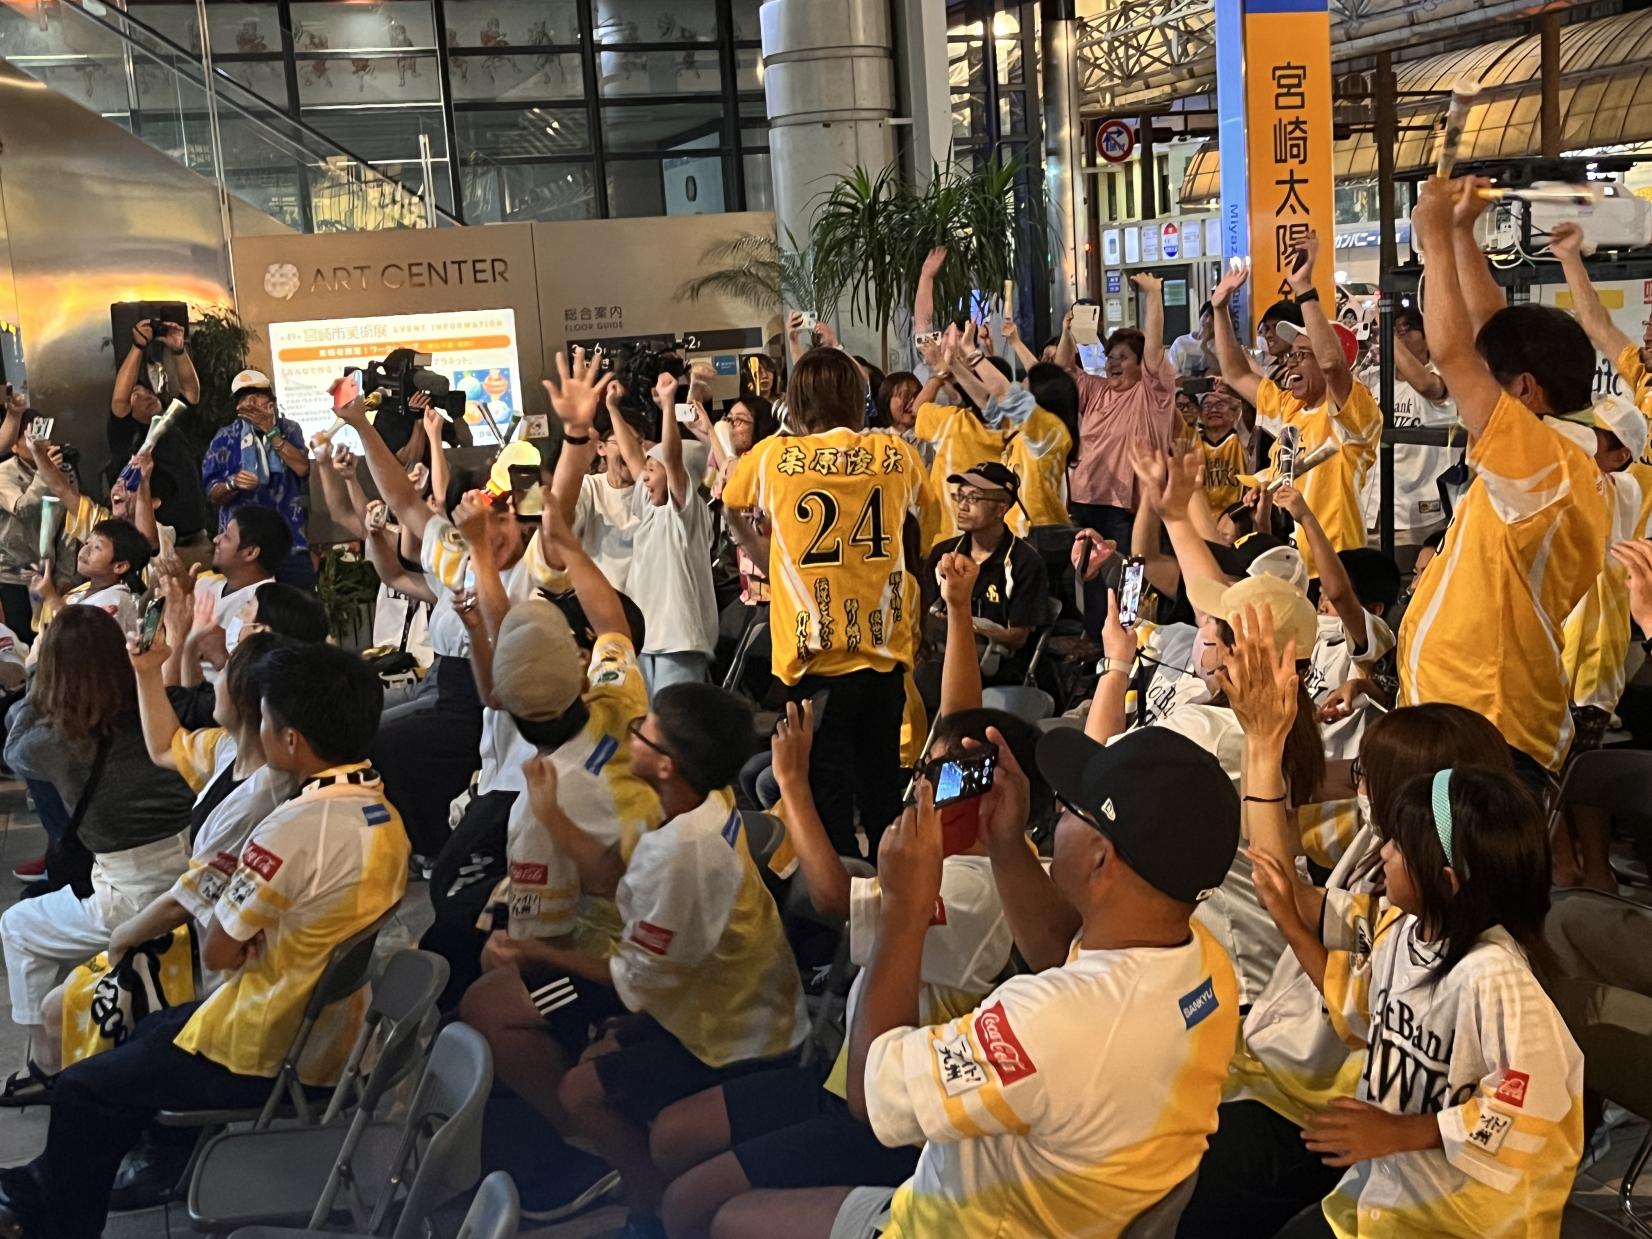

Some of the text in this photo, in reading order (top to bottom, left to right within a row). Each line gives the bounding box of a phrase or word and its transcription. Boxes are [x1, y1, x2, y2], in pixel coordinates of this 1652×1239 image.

[311, 258, 509, 292] ART CENTER
[564, 306, 623, 321] 総合案内
[597, 322, 623, 330] GUIDE
[794, 485, 892, 568] 24
[1183, 987, 1213, 1018] SANKYU
